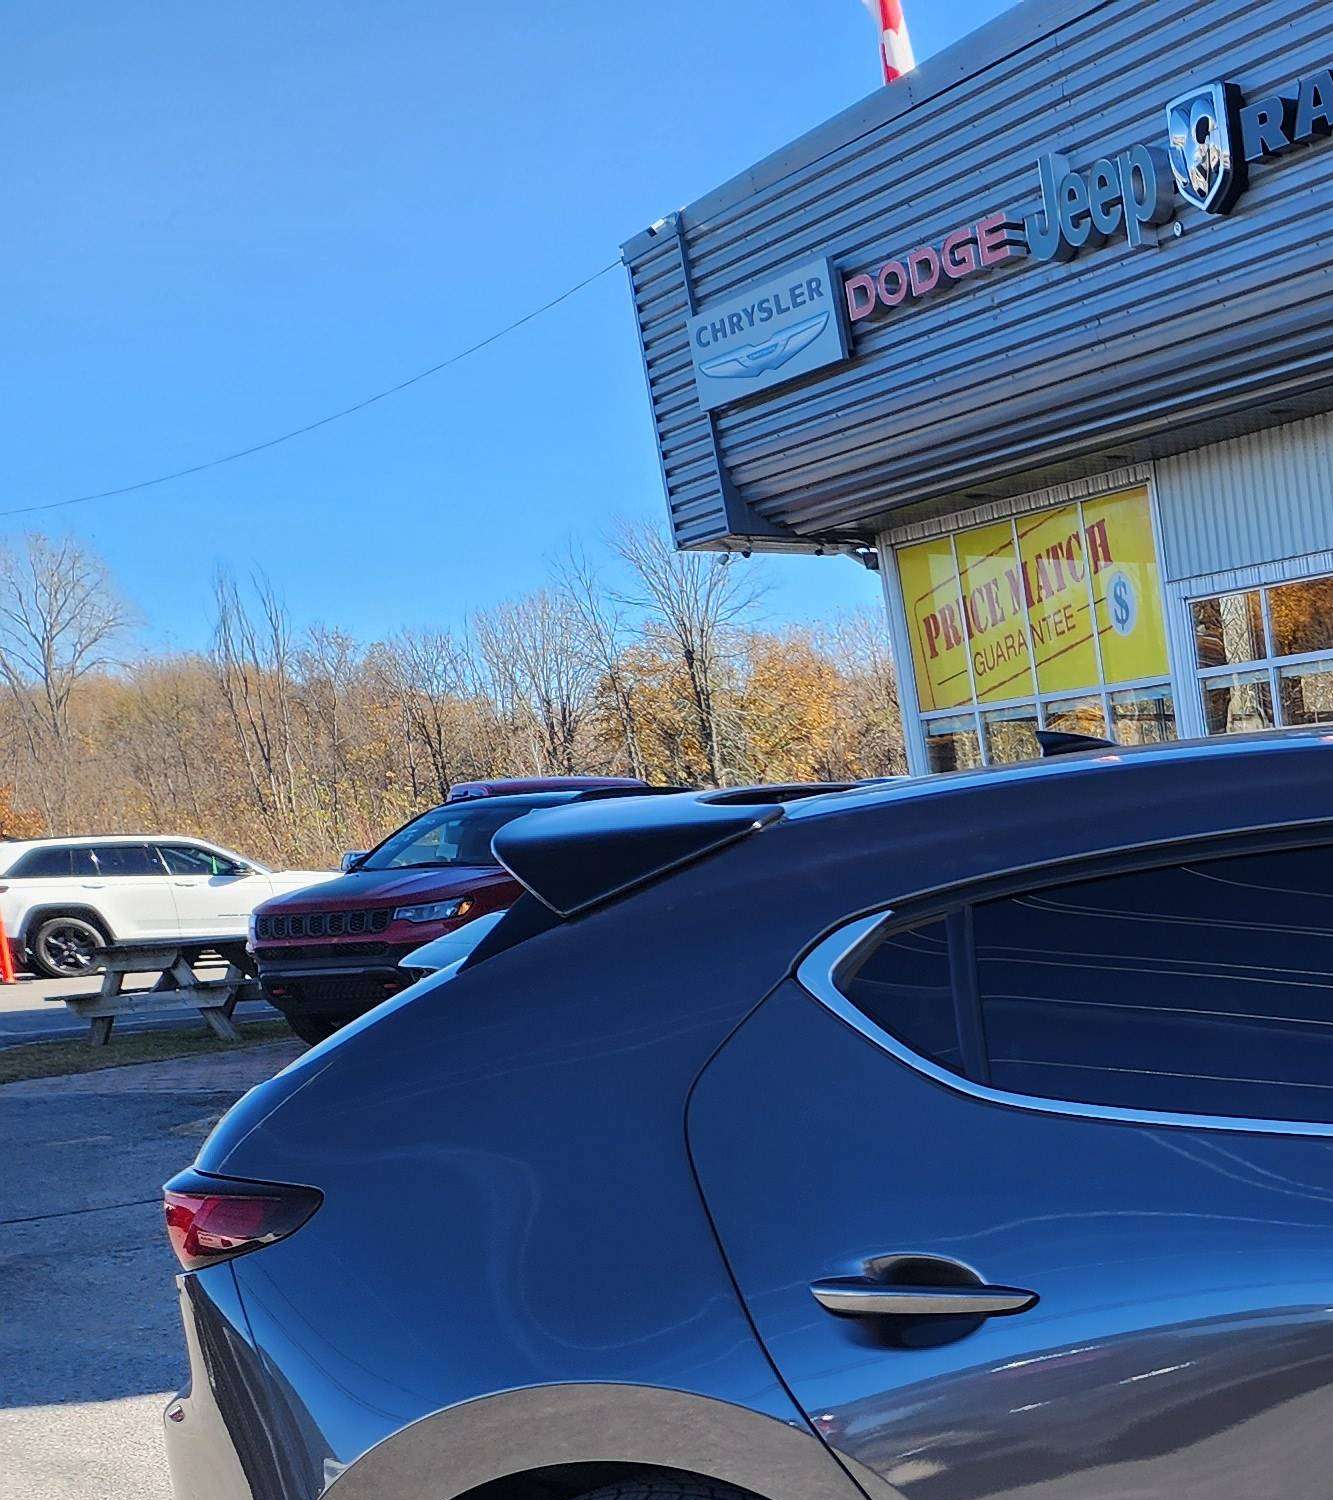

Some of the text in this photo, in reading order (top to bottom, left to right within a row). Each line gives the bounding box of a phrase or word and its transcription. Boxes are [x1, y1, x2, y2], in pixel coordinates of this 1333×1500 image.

[1025, 143, 1158, 261] Jeep
[695, 277, 824, 348] CHRYSLER
[845, 213, 1010, 321] DODGE
[922, 519, 1113, 659] PRICE MATCH
[973, 604, 1076, 676] GUARANTEE
